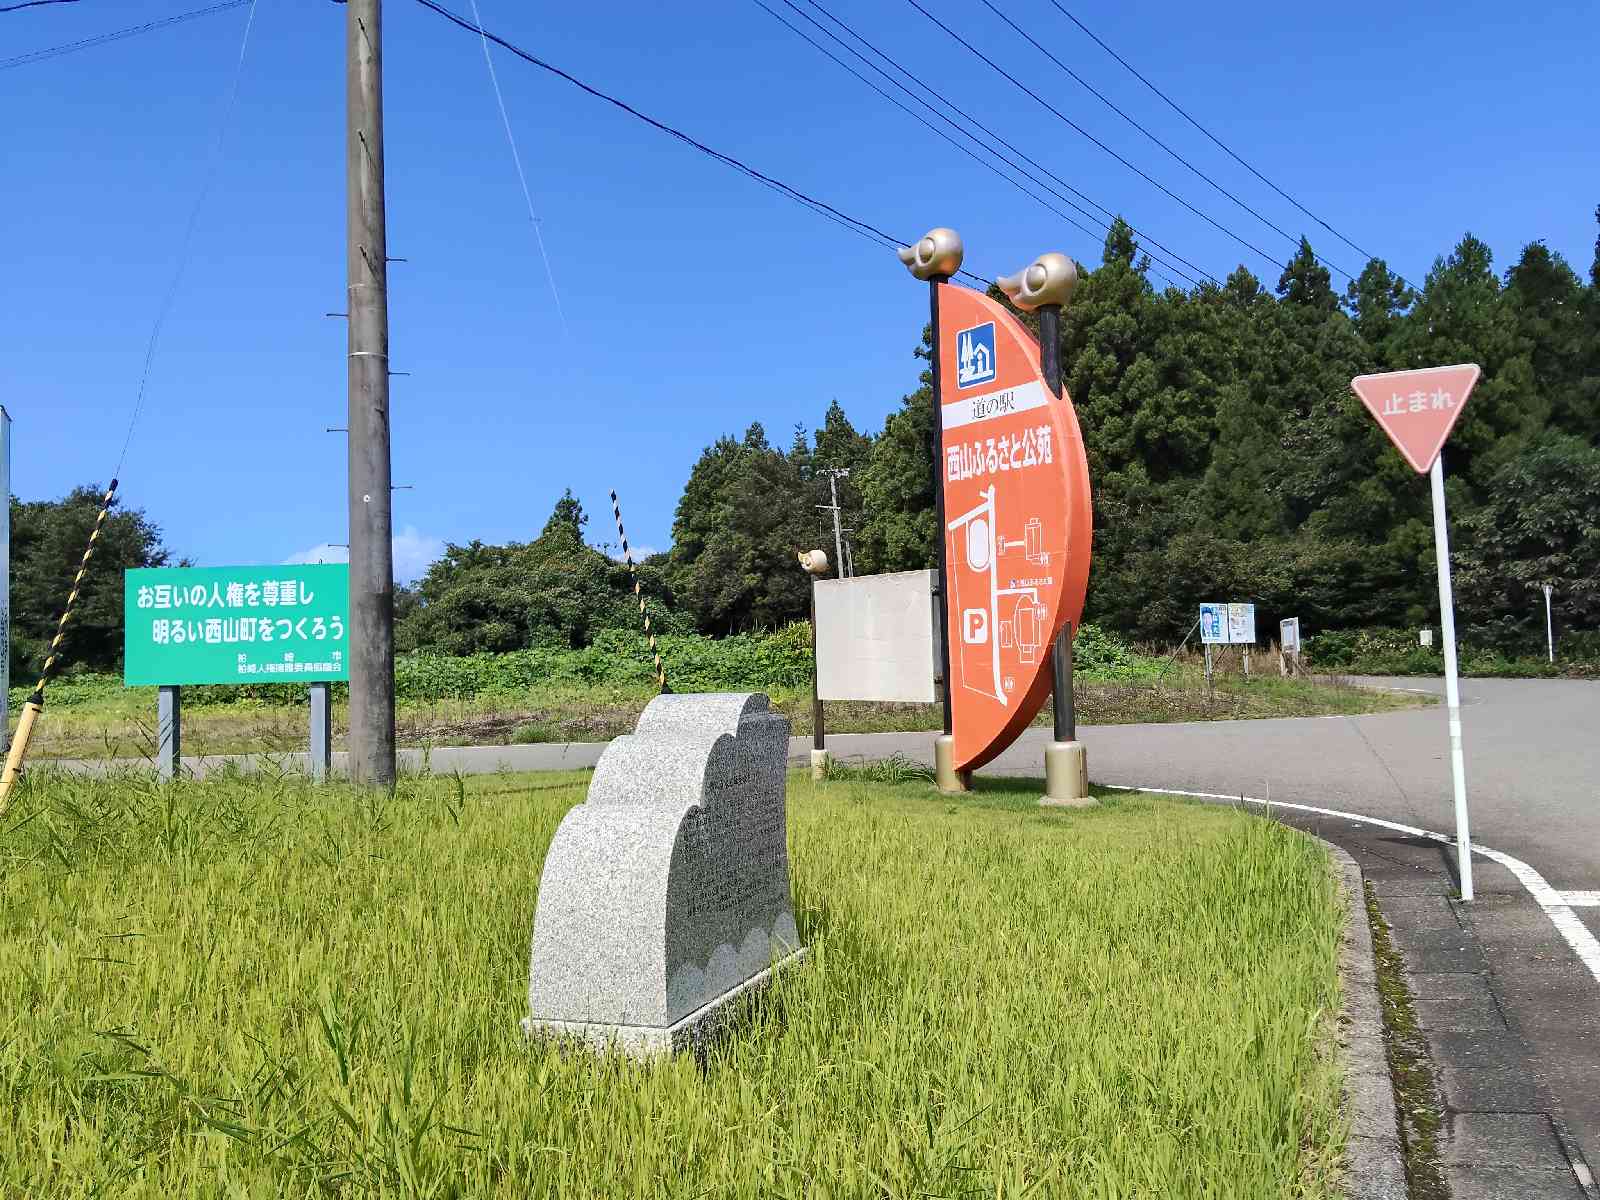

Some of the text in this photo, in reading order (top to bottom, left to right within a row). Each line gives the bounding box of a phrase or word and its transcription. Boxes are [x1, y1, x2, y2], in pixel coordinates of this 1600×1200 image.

[972, 391, 1015, 420] 道の駅
[1382, 387, 1456, 416] 止まれ
[947, 425, 1053, 482] 西山ふるさと公苑
[137, 579, 314, 609] お互いの人権を尊重し
[152, 615, 344, 644] 明るい西山町をつくろう
[969, 614, 985, 640] P
